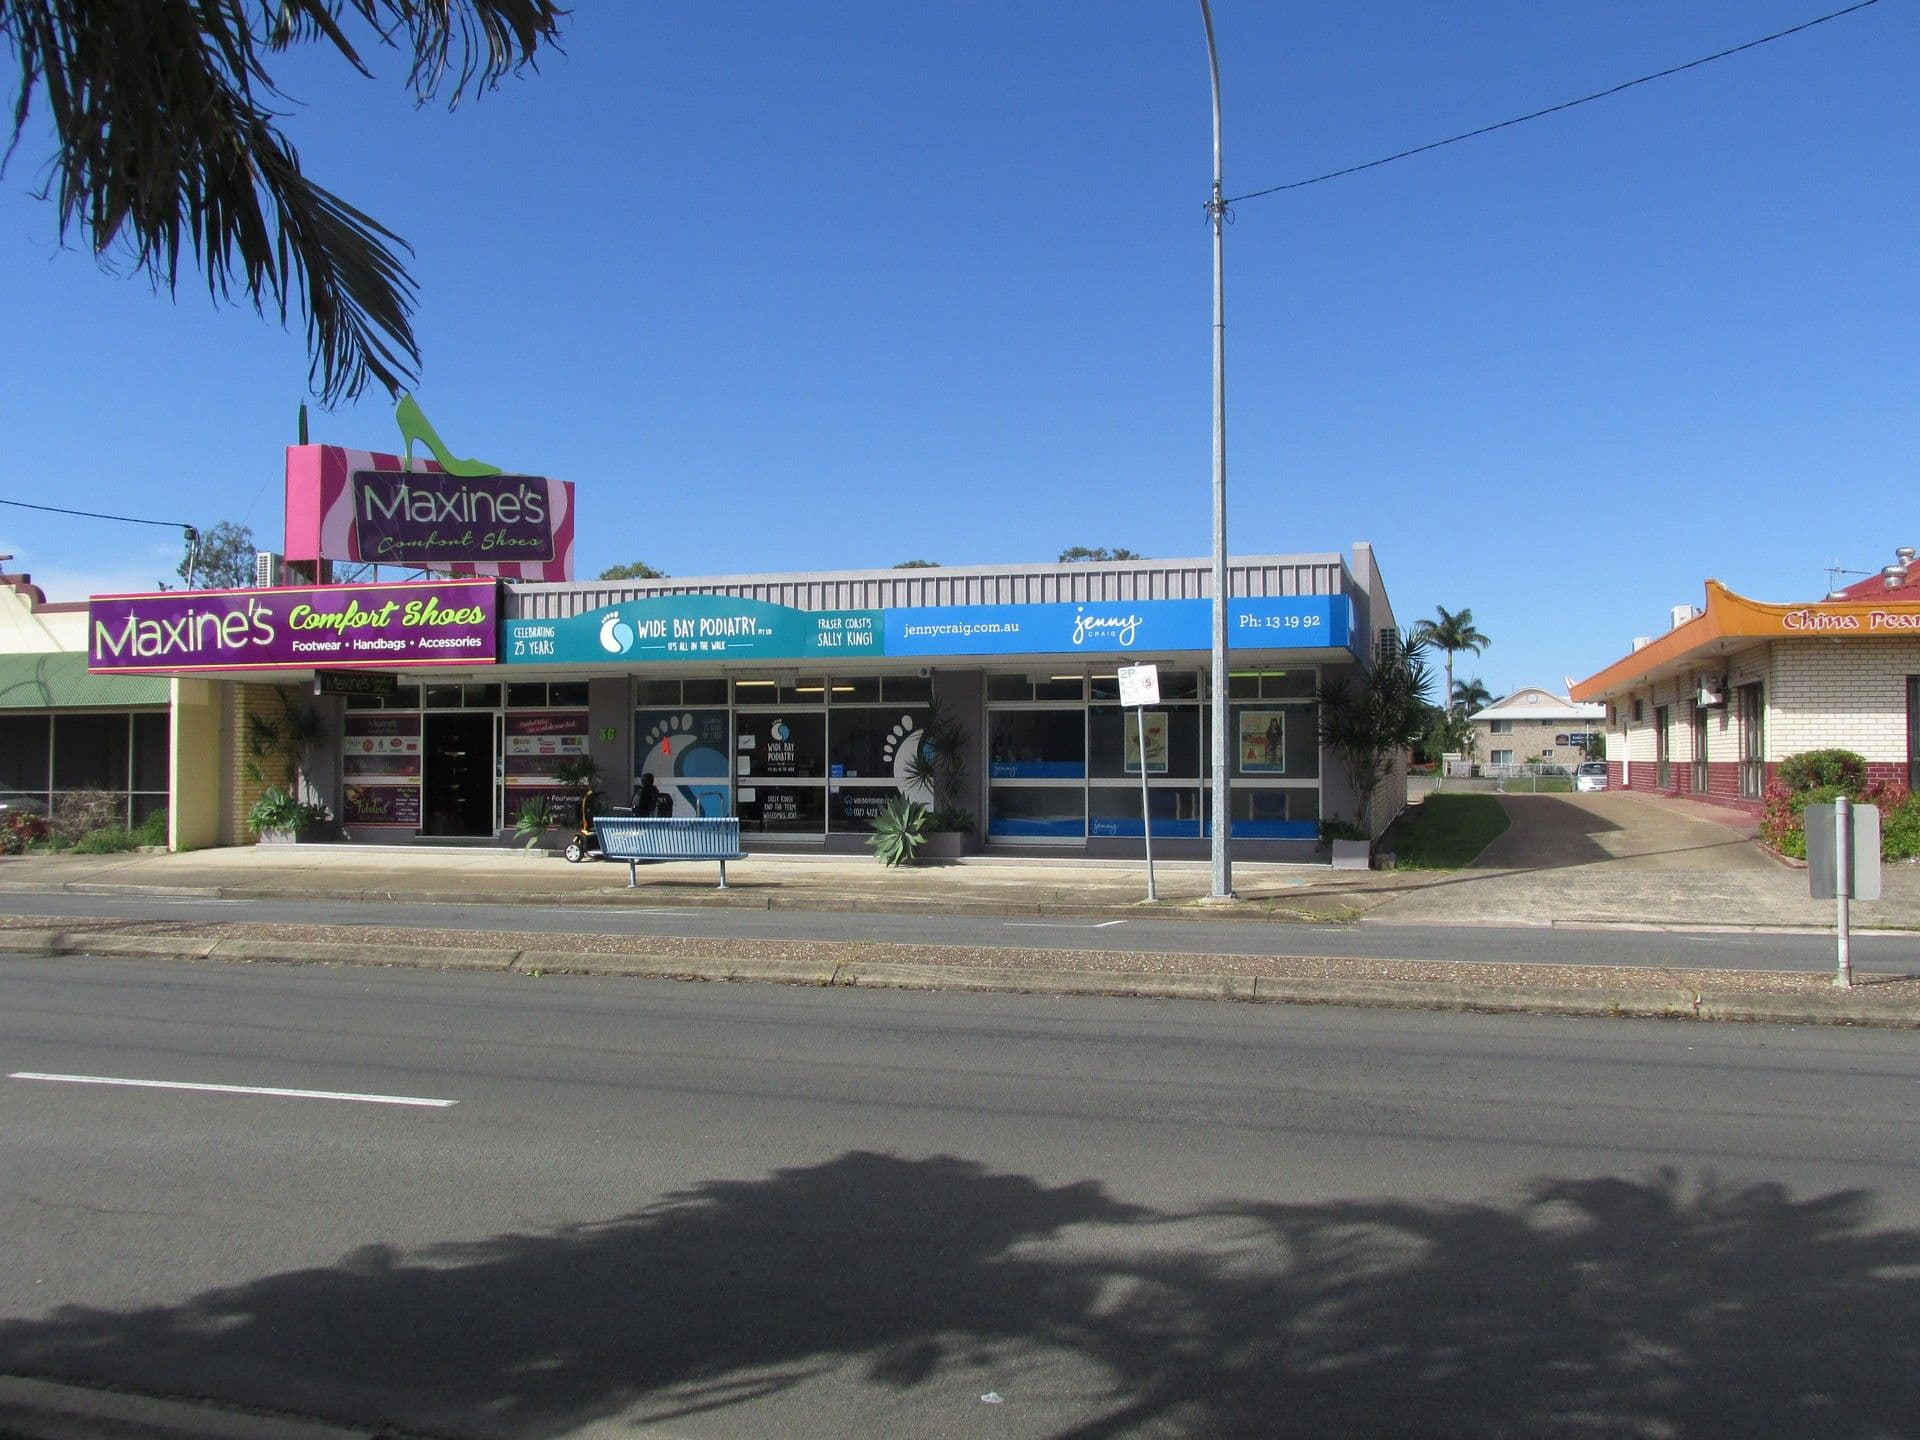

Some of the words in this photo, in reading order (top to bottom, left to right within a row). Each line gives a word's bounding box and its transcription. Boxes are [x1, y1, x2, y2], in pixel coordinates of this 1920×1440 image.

[363, 483, 545, 523] Maxine's
[377, 530, 474, 554] Comfort
[481, 527, 542, 551] Shoes
[289, 599, 400, 636] Comfort
[402, 596, 486, 627] Shoes
[817, 618, 842, 630] FRASER
[845, 617, 872, 629] COAST'S
[1239, 614, 1262, 628] Ph:
[1265, 616, 1280, 629] 13
[1284, 616, 1299, 628] 19
[1303, 615, 1320, 628] 92
[1782, 609, 1860, 631] China
[95, 598, 275, 660] Maxine's
[513, 626, 555, 639] CELEBRATING
[638, 619, 667, 639] WIDE
[673, 618, 695, 638] BAY
[700, 616, 756, 637] PODIATRY
[903, 622, 1020, 638] jennycraig.com.au
[1072, 606, 1143, 646] jenny
[292, 640, 342, 652] Footwear
[353, 638, 406, 651] Handbags
[418, 636, 482, 648] Accessories
[679, 641, 689, 651] ALL
[700, 641, 709, 651] THE
[711, 641, 726, 650] WALK
[817, 632, 842, 647] SALLY
[514, 641, 525, 656] 25
[529, 640, 554, 656] YEARS
